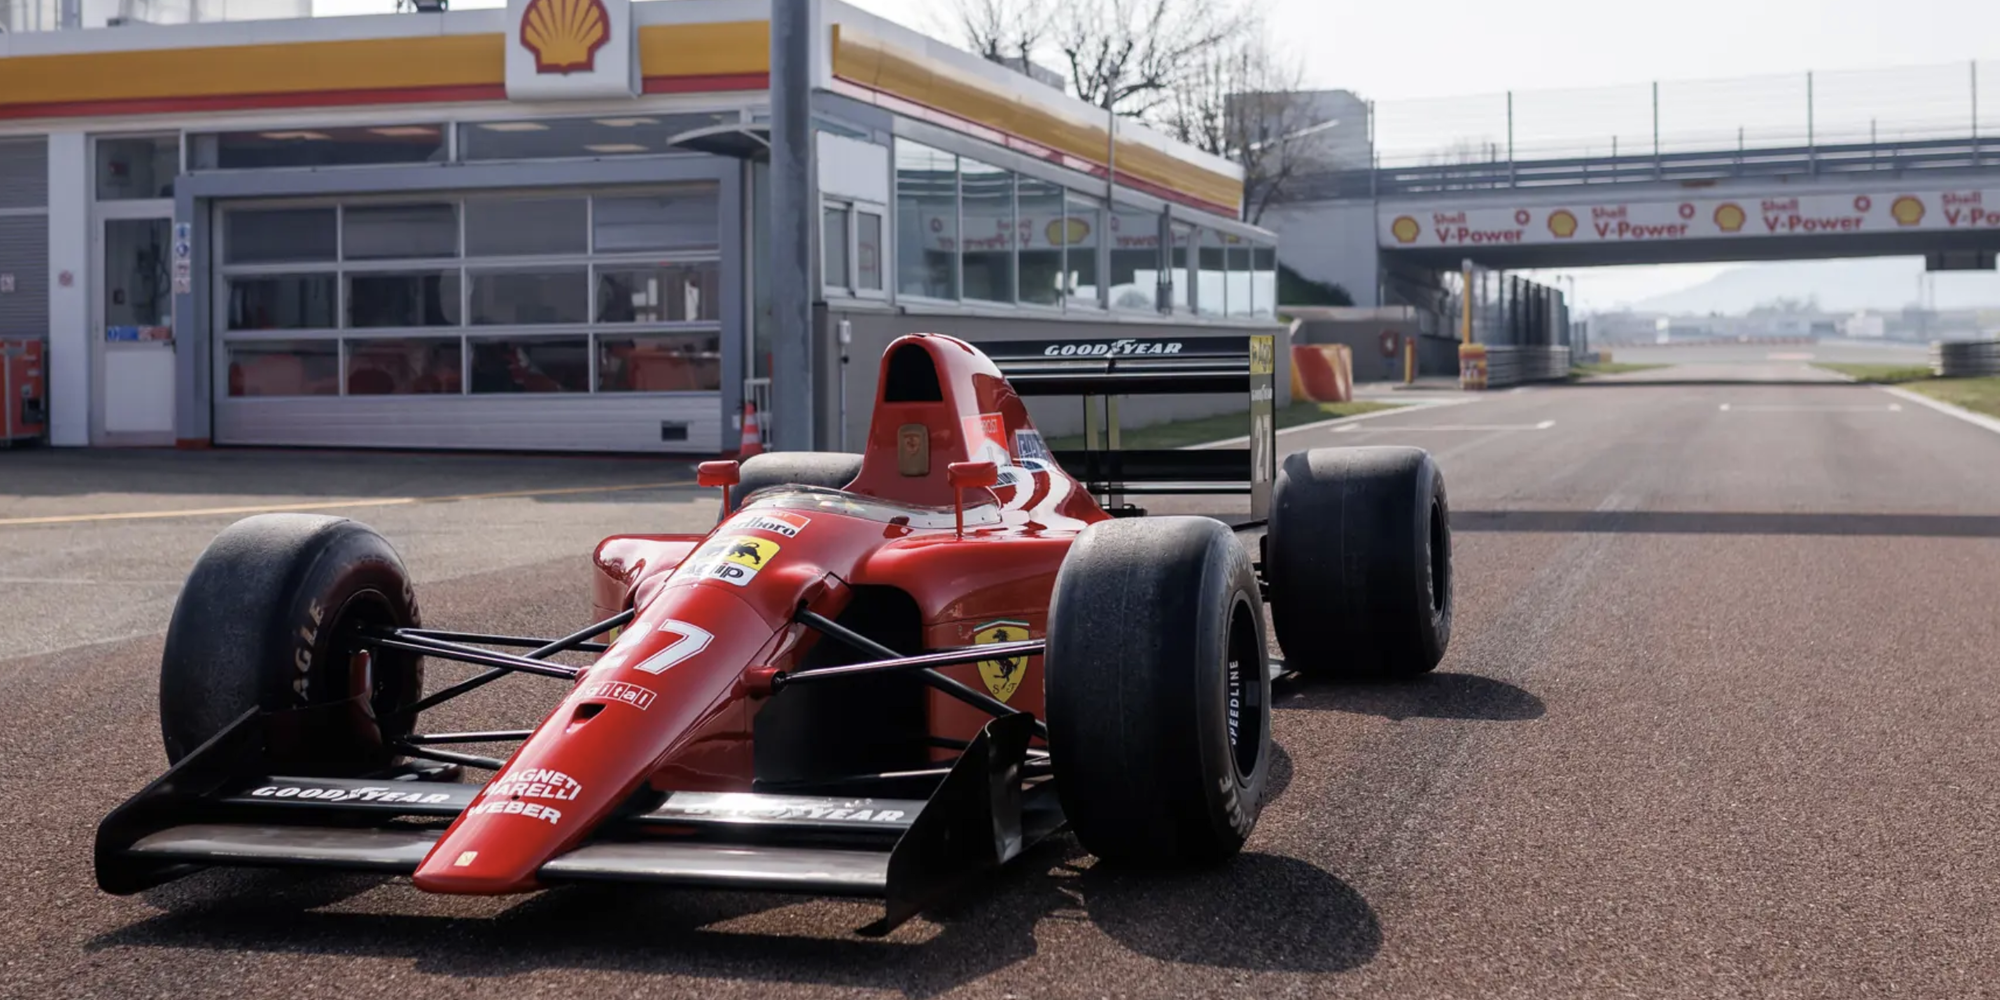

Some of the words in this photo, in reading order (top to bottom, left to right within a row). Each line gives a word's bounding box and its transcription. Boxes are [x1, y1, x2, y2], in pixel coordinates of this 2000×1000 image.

[1762, 199, 1798, 212] Shell
[1942, 191, 1982, 205] Shell
[1432, 212, 1466, 225] Shell
[1592, 205, 1627, 219] Shell
[1594, 220, 1689, 238] V-Power
[1763, 214, 1865, 233] V-Power
[1435, 227, 1524, 243] V-Power
[1044, 340, 1182, 357] GOODYEAR
[1255, 414, 1270, 484] 27
[293, 598, 324, 709] AGLE
[500, 768, 582, 794] AGNETI
[252, 786, 450, 803] GOODYEAR
[467, 801, 562, 824] WEBER
